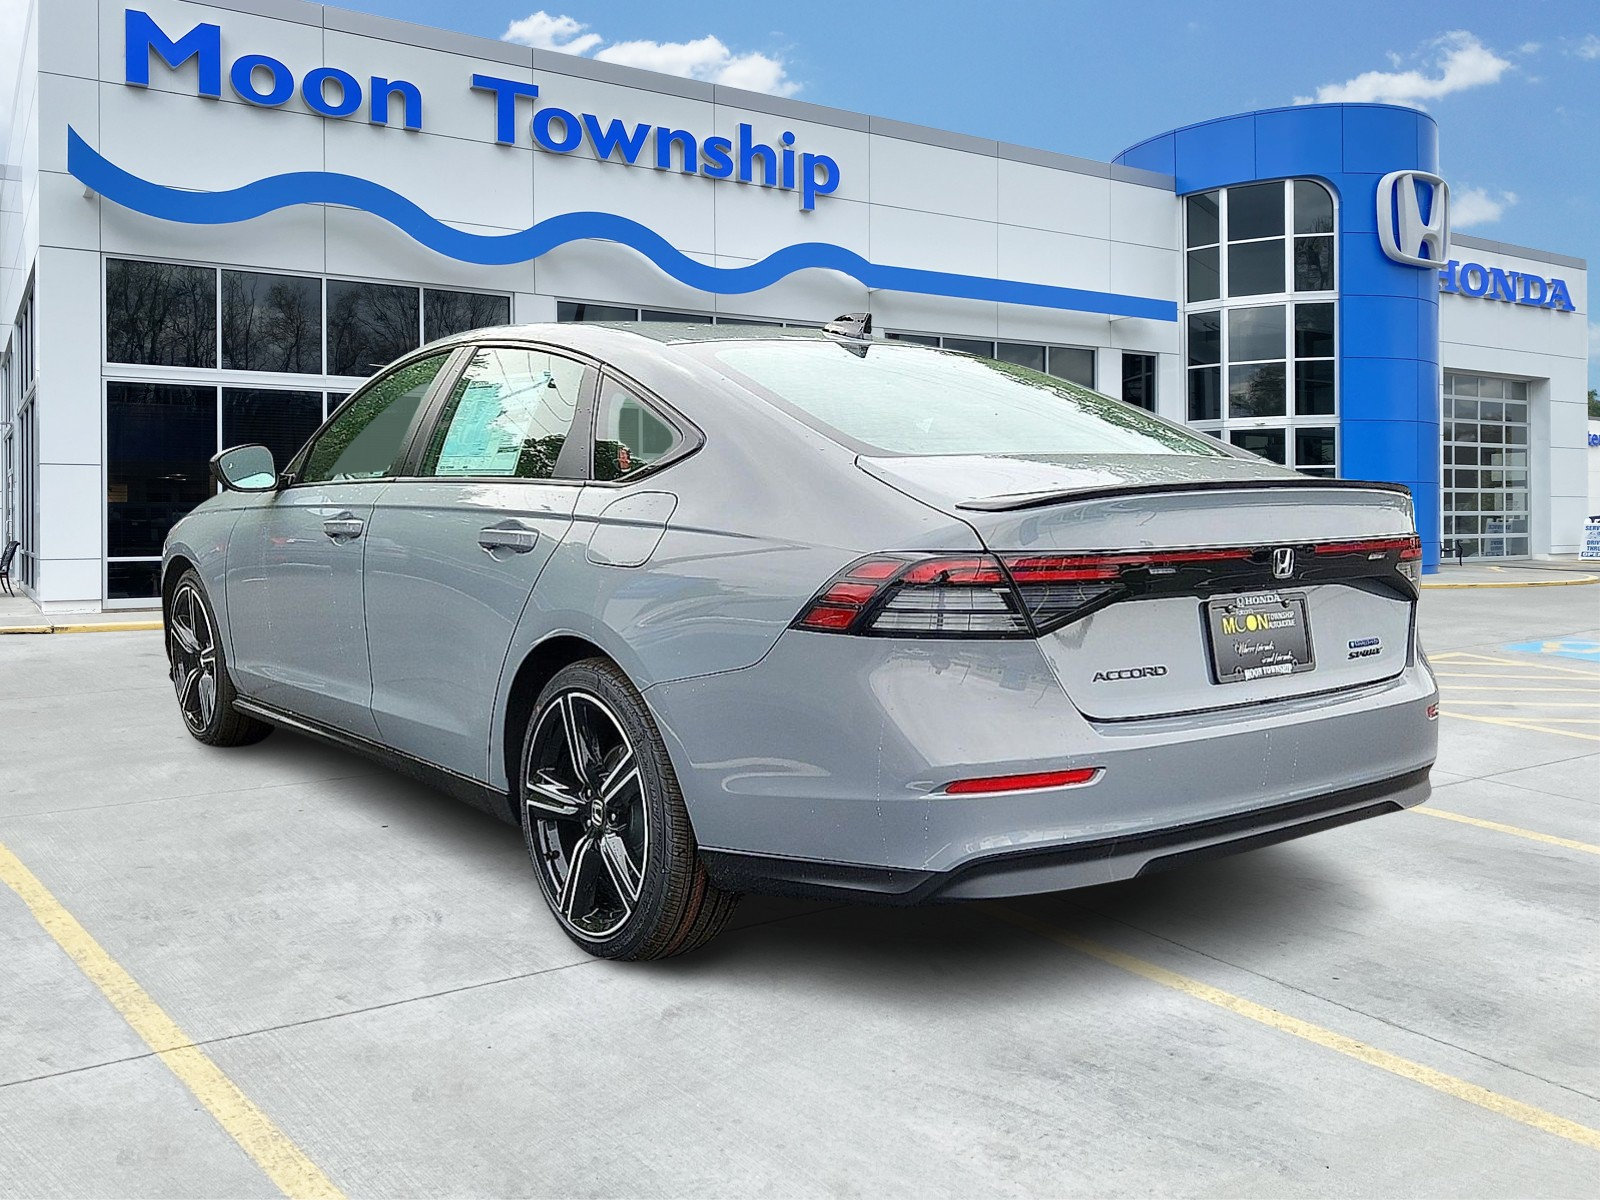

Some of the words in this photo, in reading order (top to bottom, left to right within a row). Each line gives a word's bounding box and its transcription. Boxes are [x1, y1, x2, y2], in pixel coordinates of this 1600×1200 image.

[125, 9, 422, 132] Moon
[470, 73, 840, 212] Township
[1438, 259, 1576, 312] HONDA
[1245, 594, 1281, 605] HONDA
[1092, 666, 1168, 682] ACCORD
